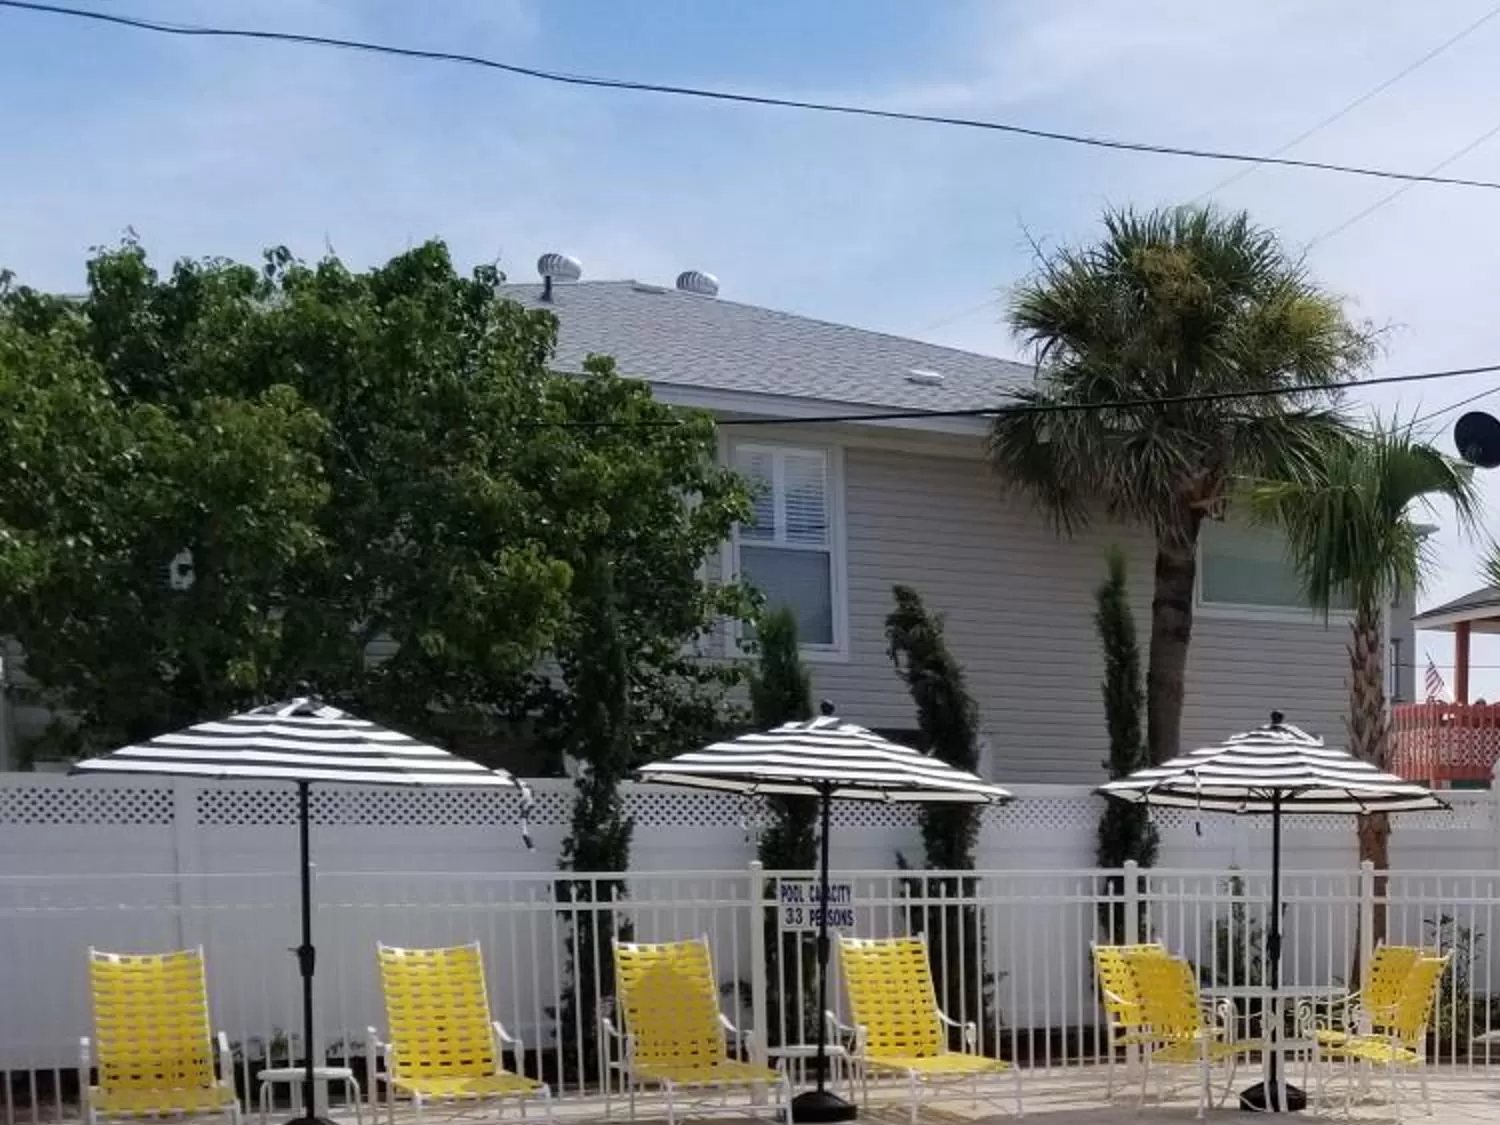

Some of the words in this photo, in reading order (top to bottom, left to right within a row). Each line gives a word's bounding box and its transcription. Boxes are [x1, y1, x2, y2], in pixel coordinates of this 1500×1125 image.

[781, 884, 804, 903] POOL
[809, 884, 852, 903] CAACITY
[785, 907, 803, 925] 33
[809, 908, 855, 927] PESONS
